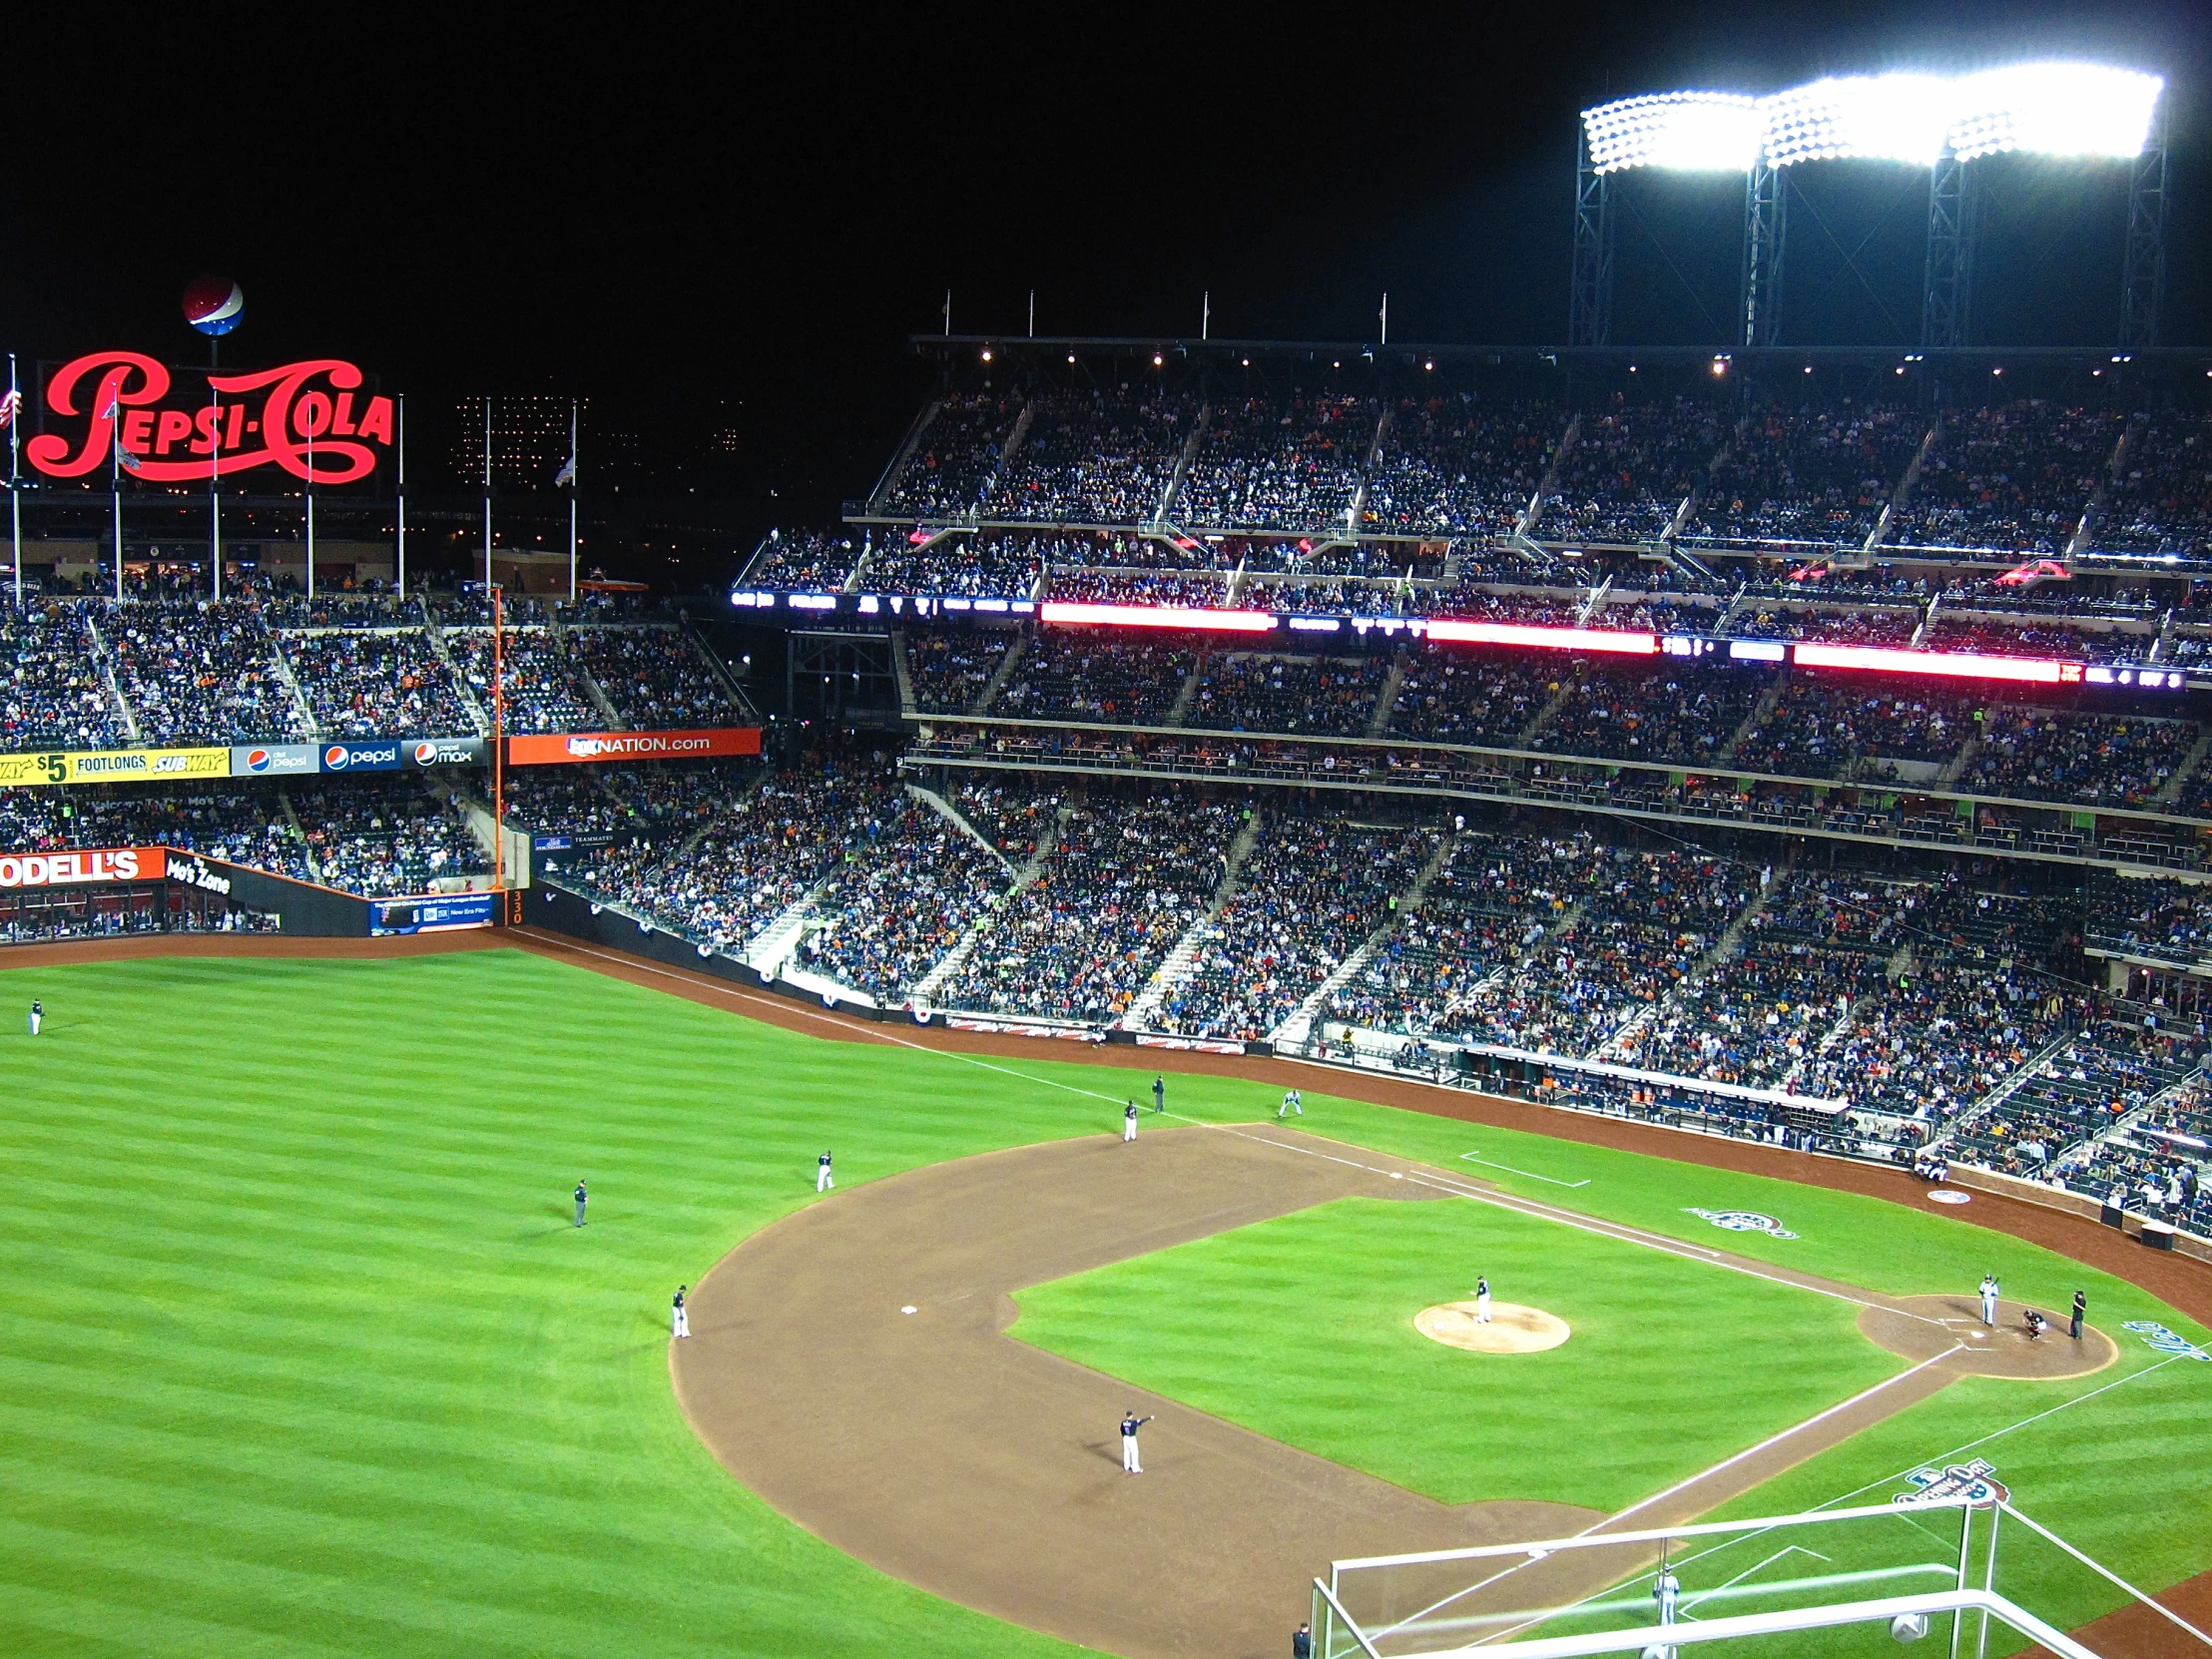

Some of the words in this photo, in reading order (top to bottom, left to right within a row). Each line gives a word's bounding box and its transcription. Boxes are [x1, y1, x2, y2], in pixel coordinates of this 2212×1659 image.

[350, 747, 396, 766] pepsi
[438, 744, 460, 753] pepsi
[438, 751, 472, 763] max
[37, 755, 67, 782] $5
[78, 756, 147, 772] FOOTLONGS
[152, 753, 227, 775] SUBWAY
[273, 757, 306, 769] pepsi
[0, 851, 139, 886] ODELL'S
[194, 856, 206, 867] The
[166, 857, 195, 883] Mo's
[195, 868, 231, 894] Zone
